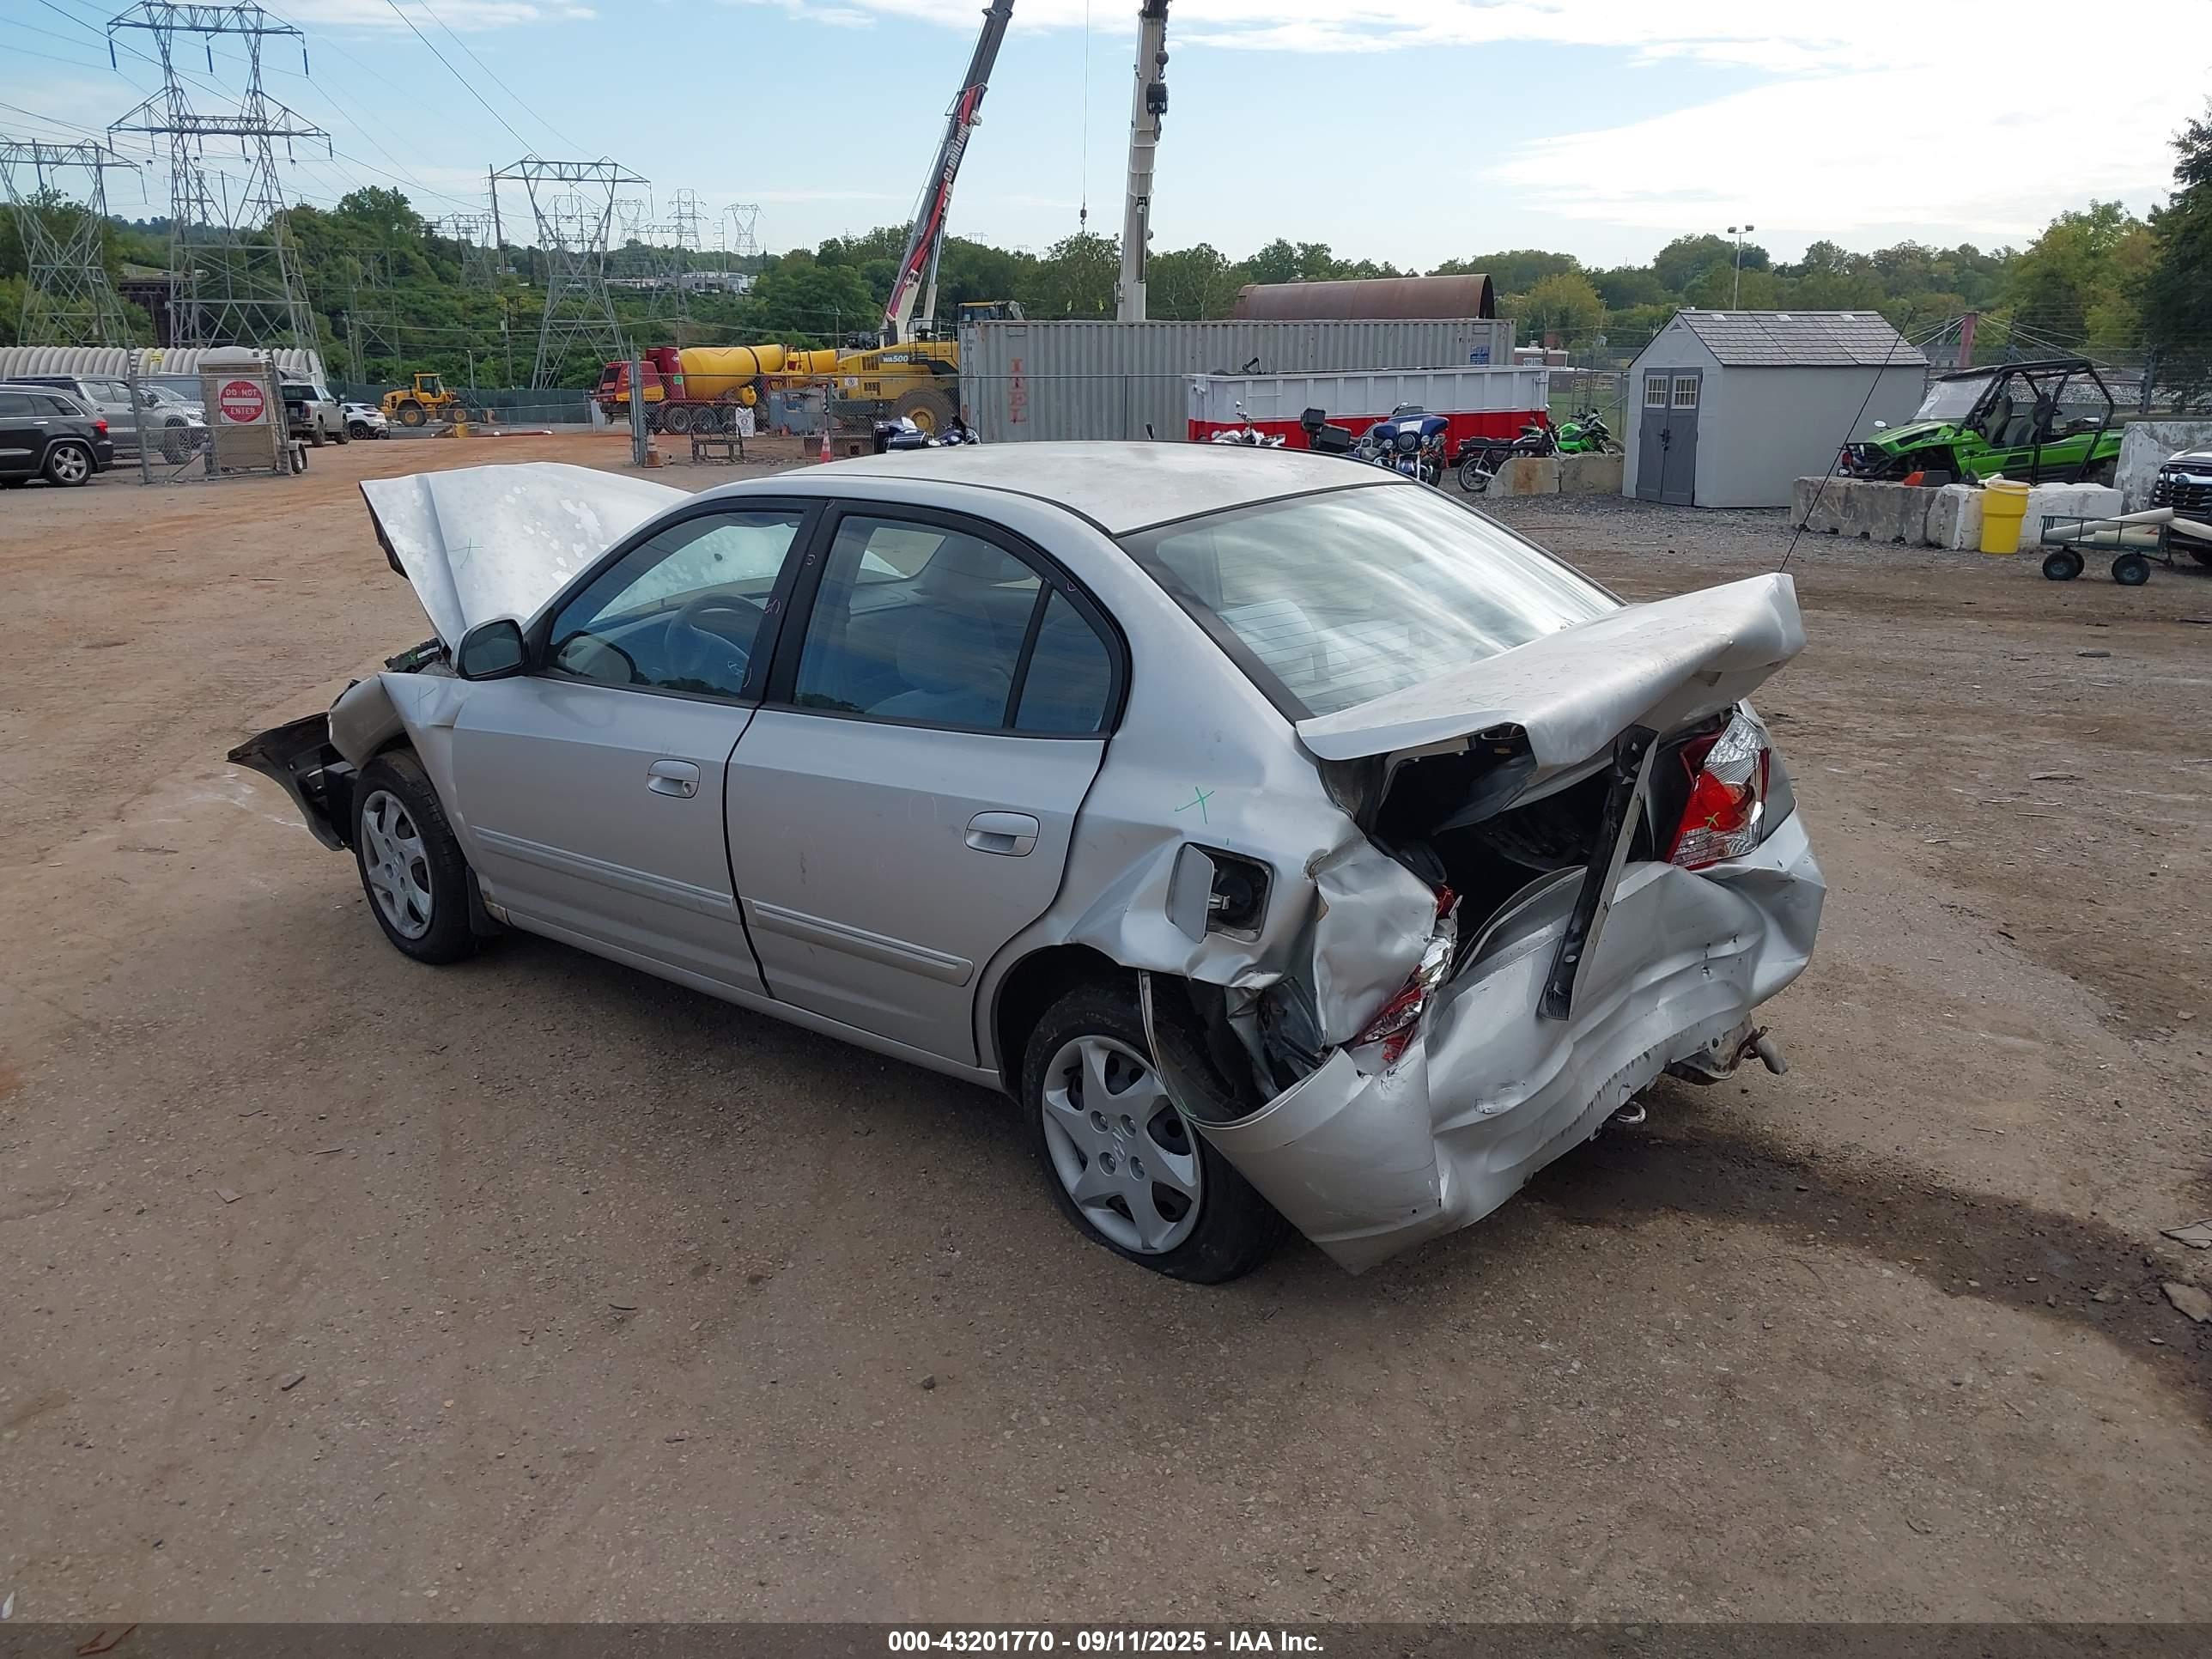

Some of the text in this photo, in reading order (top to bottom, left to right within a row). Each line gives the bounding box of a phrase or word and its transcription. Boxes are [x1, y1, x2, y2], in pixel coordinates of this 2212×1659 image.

[943, 122, 970, 183] CJ DRILLING
[883, 355, 909, 364] WA500
